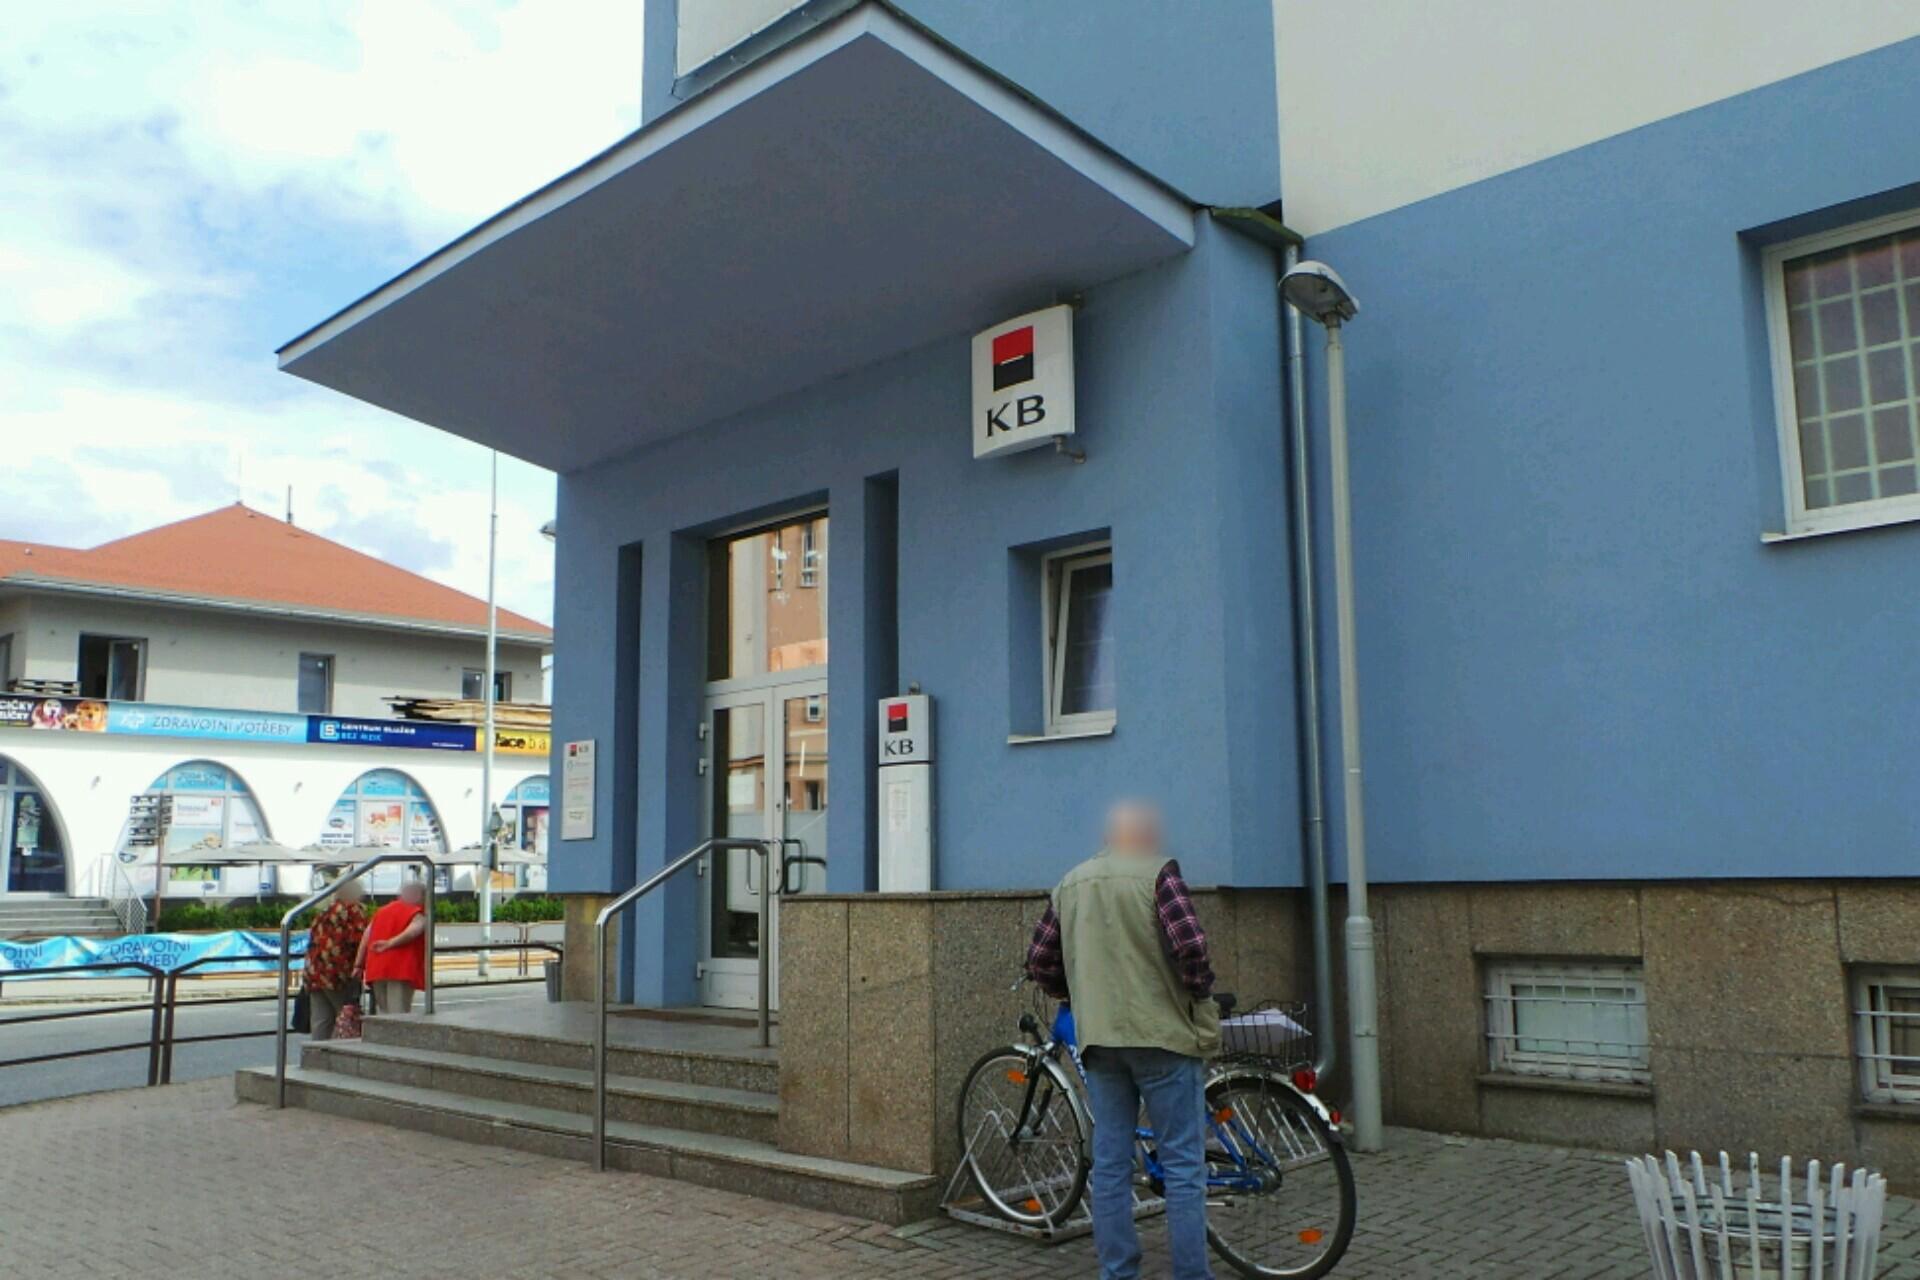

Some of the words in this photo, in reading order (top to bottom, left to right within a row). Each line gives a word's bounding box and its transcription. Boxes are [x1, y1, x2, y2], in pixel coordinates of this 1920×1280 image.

[986, 394, 1046, 438] KB
[152, 716, 232, 732] ZDRAVOTNÍ
[236, 719, 292, 735] POTŘEBY
[885, 739, 914, 756] KB
